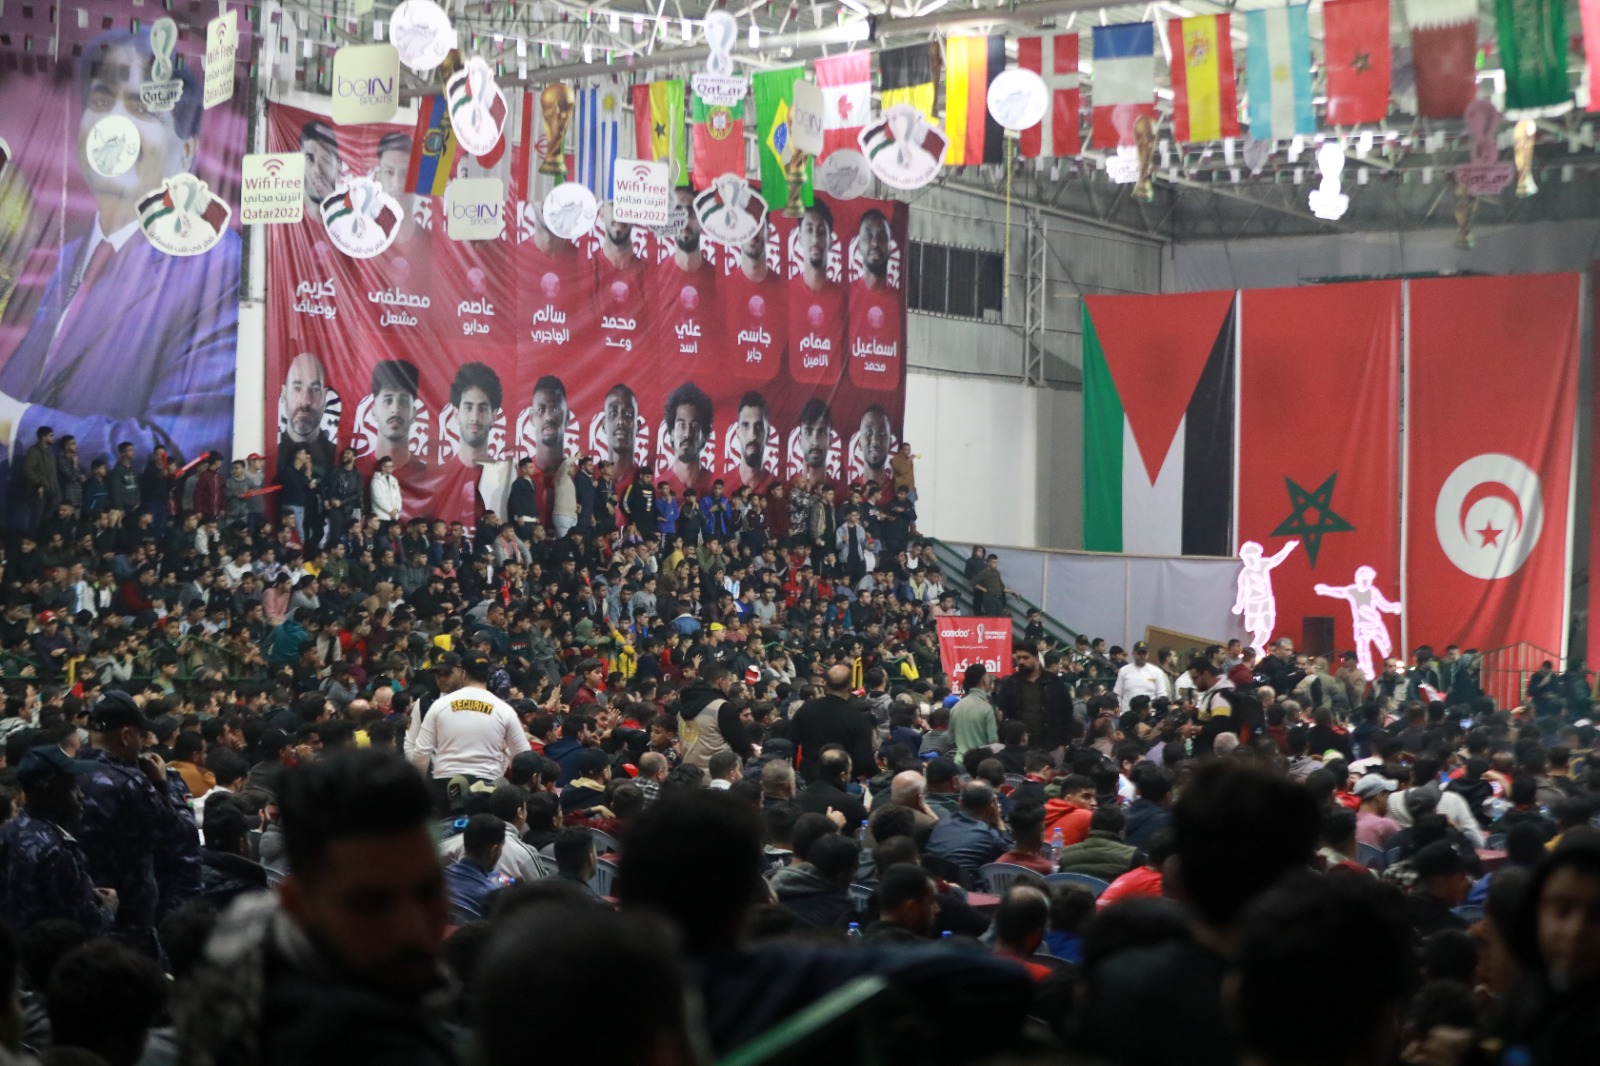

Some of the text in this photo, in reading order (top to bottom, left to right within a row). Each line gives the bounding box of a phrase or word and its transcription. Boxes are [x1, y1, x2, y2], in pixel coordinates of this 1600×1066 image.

[338, 74, 392, 98] beIN
[245, 177, 300, 190] Wifi Free
[616, 180, 666, 195] Wifi Free
[244, 193, 273, 205] مجاني
[243, 208, 300, 219] Qatar2022
[453, 200, 498, 219] beIN
[616, 208, 666, 222] Qatar2022
[296, 278, 336, 299] كريم
[368, 287, 430, 308] مصطفى
[292, 299, 336, 320] بوضياف
[458, 297, 494, 317] عاصم
[533, 304, 566, 325] سالم
[380, 310, 418, 326] مشعل
[601, 316, 636, 330] محمد
[463, 319, 490, 336] مدابو
[675, 319, 701, 339] علي
[531, 328, 569, 345] الهاجري
[738, 326, 771, 348] جاسم
[800, 332, 831, 351] همام
[746, 347, 762, 363] جابر
[852, 337, 897, 358] اسماعيل
[864, 362, 886, 372] محمد
[452, 700, 493, 714] SECURITY
